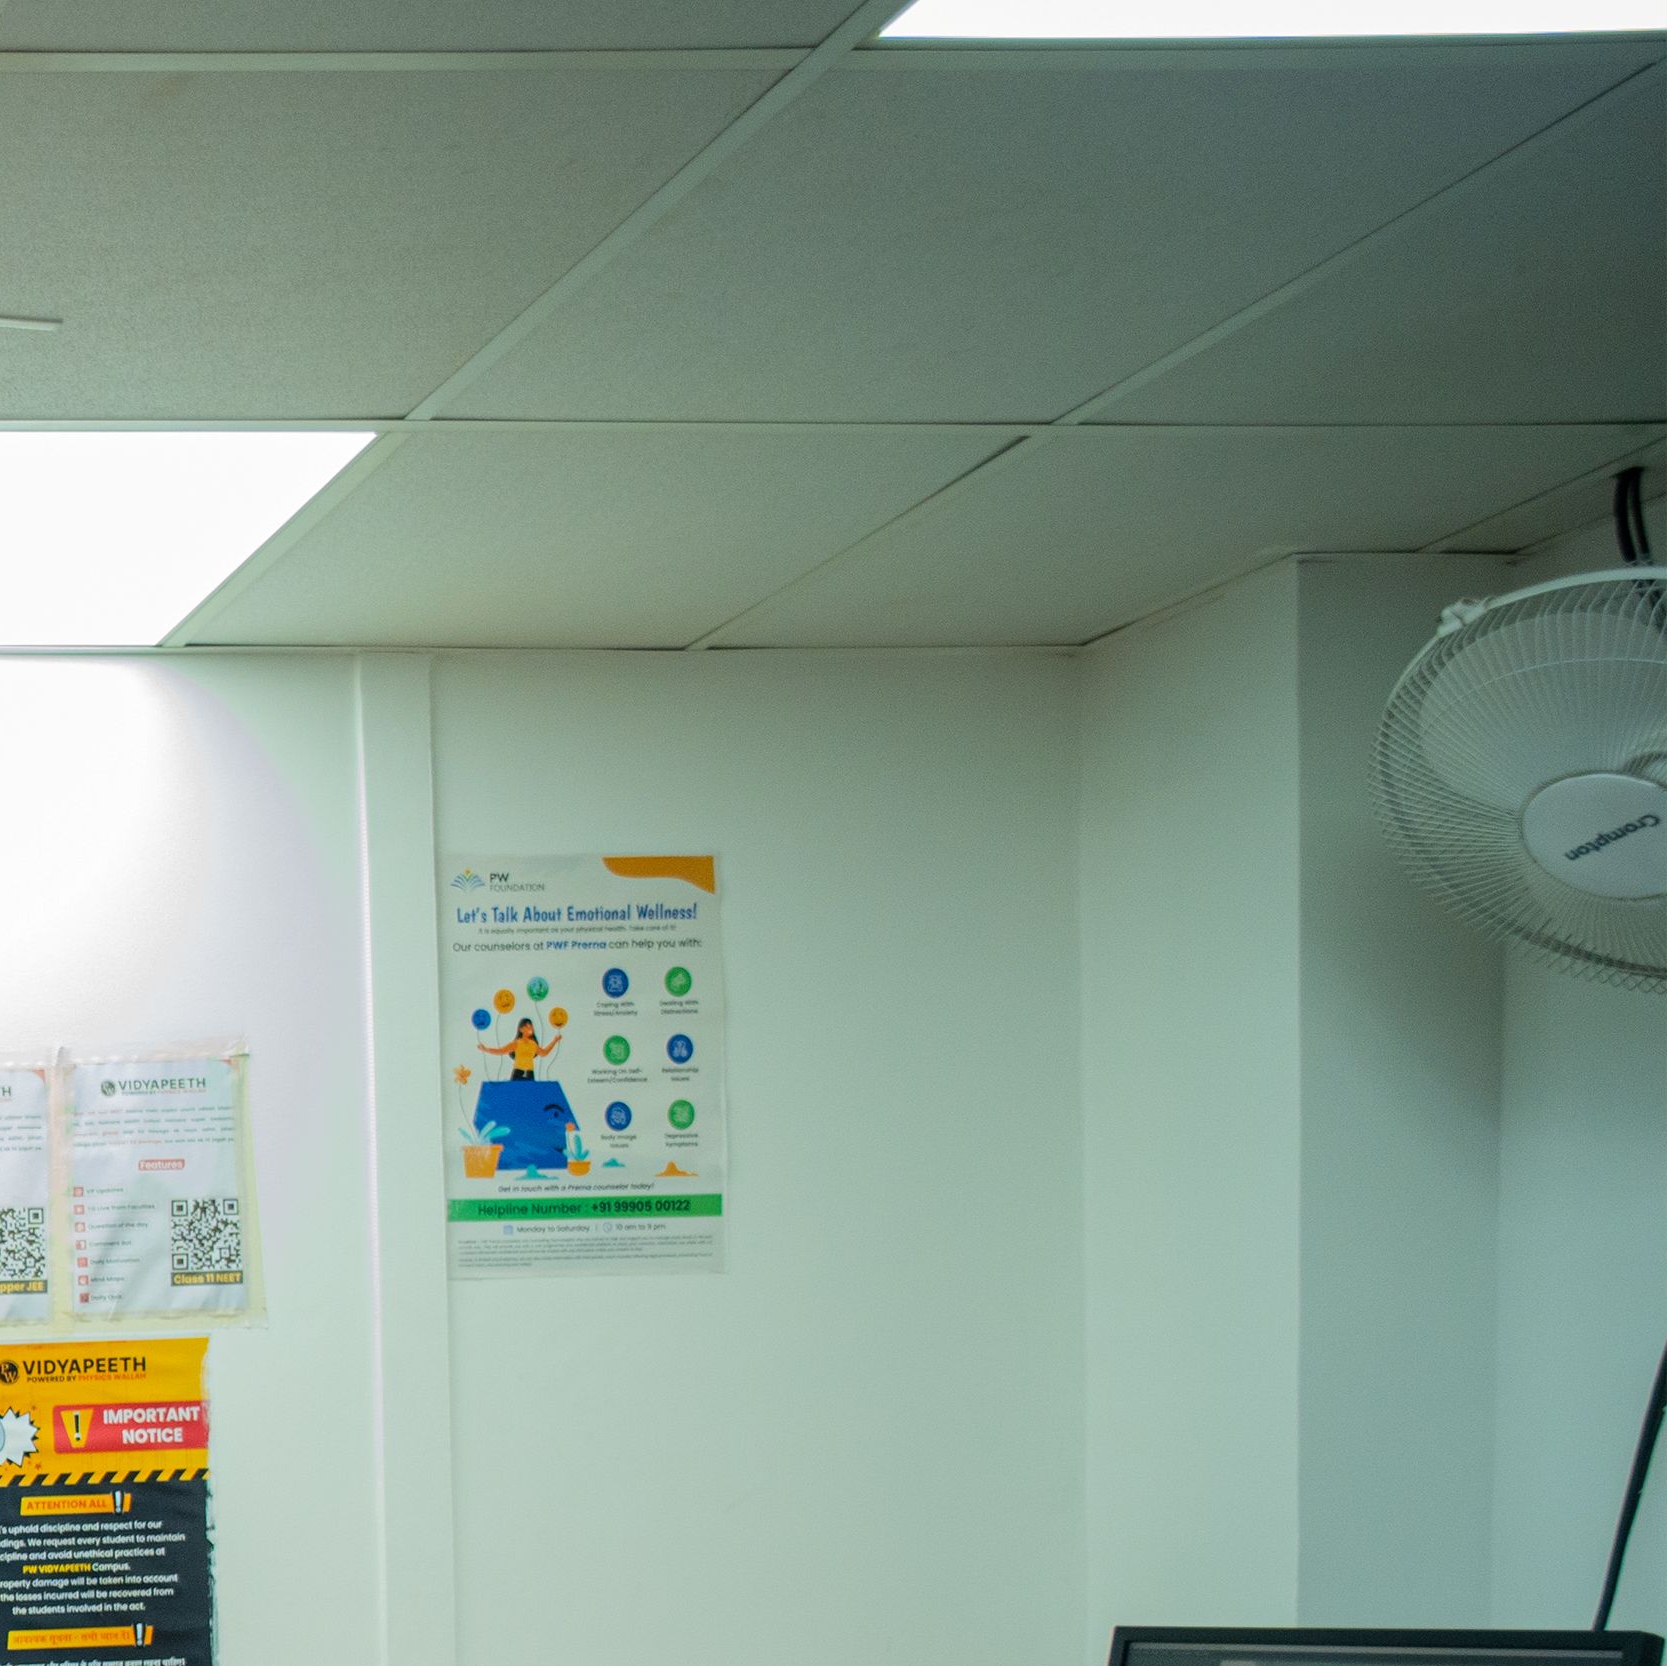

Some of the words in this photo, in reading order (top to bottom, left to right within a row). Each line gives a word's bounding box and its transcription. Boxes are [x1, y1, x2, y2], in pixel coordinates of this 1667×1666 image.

[1565, 814, 1660, 860] Crompton
[490, 873, 509, 882] PW
[490, 883, 545, 892] FOUNDATION
[457, 907, 487, 924] Let's
[491, 906, 518, 923] Talk
[523, 906, 561, 922] About
[567, 903, 631, 922] Emotional
[636, 902, 697, 920] Wellness!
[453, 943, 471, 952] Our
[474, 942, 531, 952] counselors
[533, 941, 544, 951] at
[546, 941, 569, 950] PWF
[571, 940, 607, 949] Prerna
[608, 940, 629, 949] can
[632, 939, 654, 949] help
[657, 940, 676, 949] you
[678, 938, 702, 948] with:
[118, 1077, 206, 1090] VIDYAPEETH
[140, 1160, 183, 1170] Features
[593, 1183, 629, 1191] counselor
[478, 1204, 528, 1217] Helpline
[531, 1203, 581, 1214] Number
[591, 1201, 613, 1213] +91
[614, 1200, 652, 1212] 99905
[655, 1199, 690, 1212] 00122
[517, 1225, 546, 1235] Monday
[557, 1223, 590, 1234] Saturday
[174, 1274, 203, 1284] Class
[205, 1274, 215, 1283] 11
[216, 1272, 241, 1282] NEET
[26, 1281, 44, 1292] JEE
[23, 1357, 146, 1375] VIDYAPEETH
[103, 1406, 200, 1424] IMPORTANT
[122, 1428, 183, 1444] NOTICE
[27, 1500, 86, 1510] ATTENTION
[90, 1500, 107, 1508] ALL
[9, 1525, 38, 1535] uphold
[40, 1523, 80, 1534] discipline
[82, 1522, 99, 1531] and
[101, 1521, 133, 1533] respect
[134, 1520, 146, 1529] for
[28, 1538, 41, 1547] We
[43, 1537, 75, 1548] request
[77, 1537, 100, 1546] every
[102, 1534, 134, 1544] student
[136, 1534, 145, 1543] to
[147, 1533, 185, 1542] maintain
[29, 1551, 46, 1561] and
[48, 1549, 72, 1560] avoid
[74, 1548, 113, 1559] unethical
[115, 1547, 154, 1558] practices
[156, 1547, 165, 1556] at
[23, 1565, 37, 1574] PW
[40, 1564, 91, 1574] VIDYAPEETH
[92, 1563, 131, 1573] Campus.
[32, 1578, 69, 1589] damage
[70, 1577, 85, 1586] will
[86, 1577, 97, 1585] be
[99, 1576, 124, 1585] taken
[125, 1575, 141, 1584] into
[143, 1573, 178, 1583] account
[0, 1593, 14, 1602] the
[16, 1592, 42, 1602] losses
[44, 1591, 79, 1601] incurred
[81, 1590, 95, 1599] will
[95, 1590, 107, 1599] be
[109, 1588, 152, 1598] recovered
[153, 1588, 174, 1596] from
[13, 1606, 27, 1615] the
[28, 1605, 65, 1614] students
[67, 1603, 103, 1613] involved
[104, 1603, 112, 1611] in
[114, 1602, 127, 1611] the
[129, 1602, 145, 1611] act.
